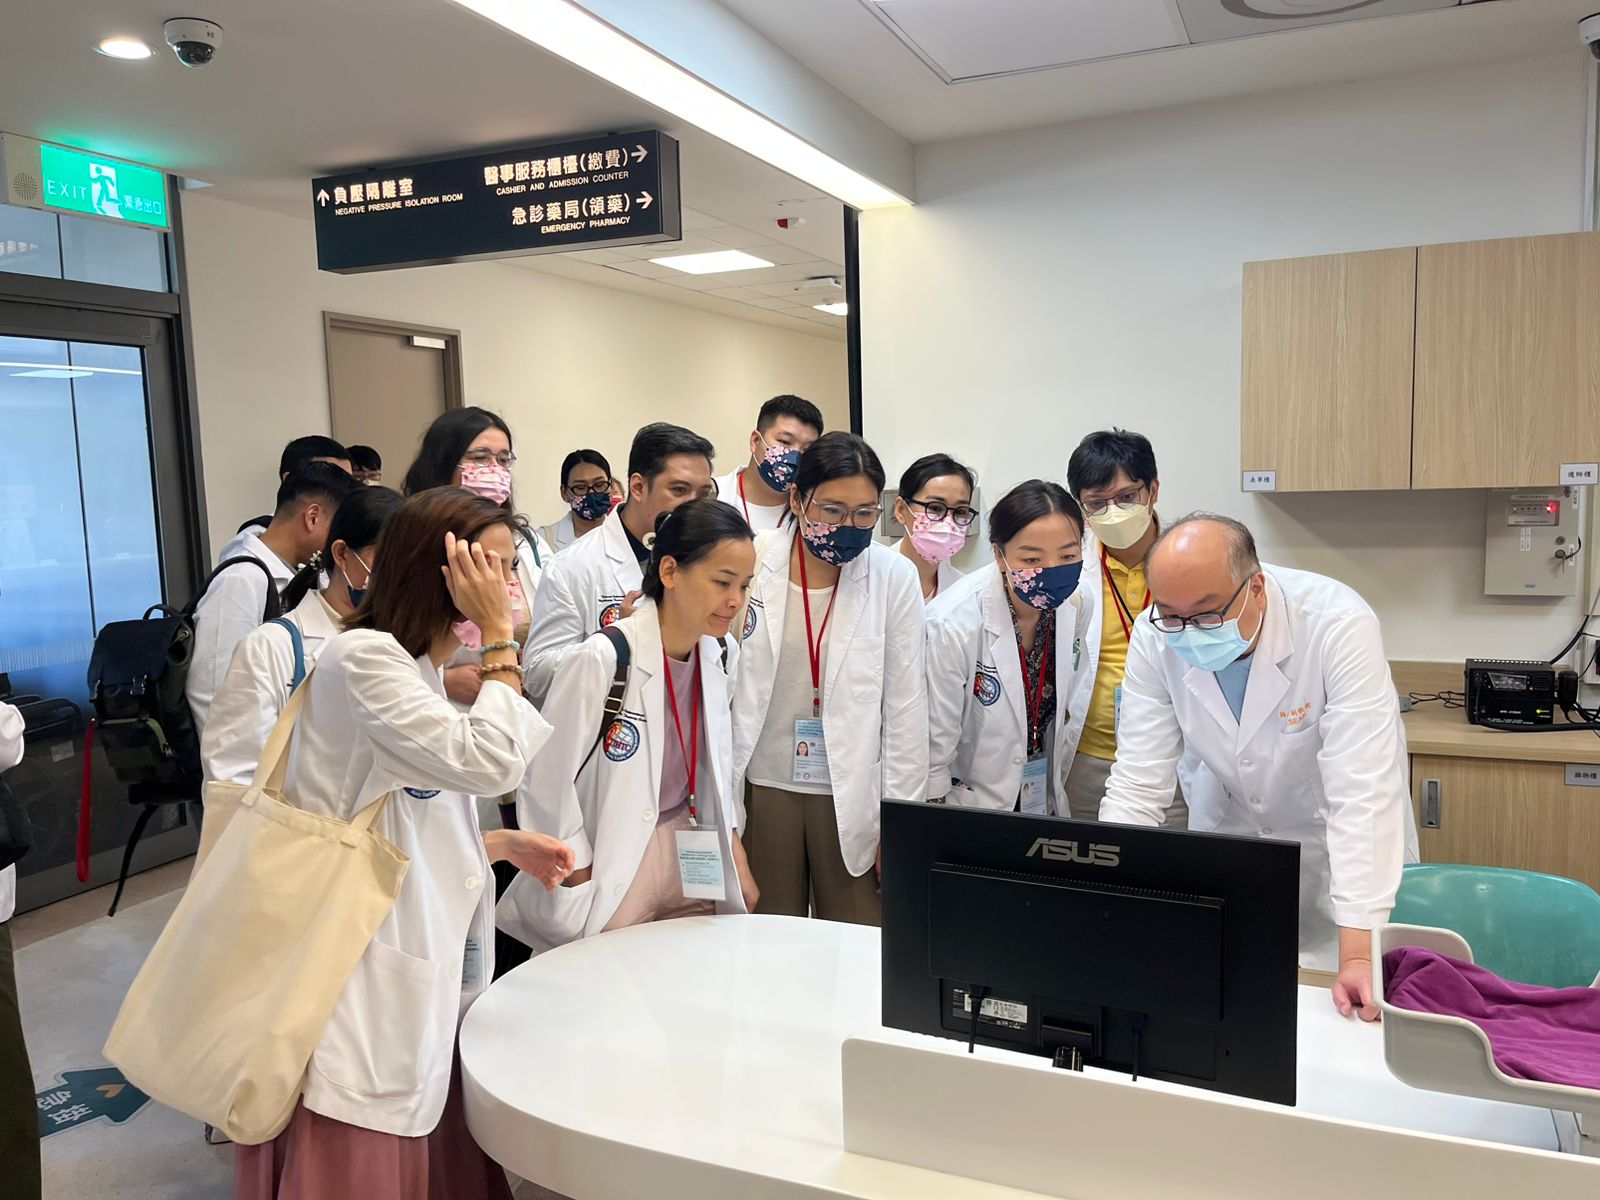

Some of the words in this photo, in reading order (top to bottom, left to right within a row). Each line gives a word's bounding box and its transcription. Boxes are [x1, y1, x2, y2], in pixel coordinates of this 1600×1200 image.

[47, 179, 87, 200] EXIT
[333, 178, 414, 205] 負壓隔離室
[496, 184, 526, 196] CASHIER
[530, 182, 545, 191] AND
[549, 176, 589, 189] ADMISSION
[593, 171, 629, 183] COUNTER
[123, 195, 162, 215] 緊急出口
[335, 205, 366, 216] NEGATIVE
[368, 200, 402, 212] PRESSURE
[405, 196, 439, 208] ISOLATION
[442, 193, 463, 203] ROOM
[541, 221, 586, 234] EMERGENCY
[589, 216, 631, 228] PHARMACY
[1025, 837, 1120, 867] ASUS
